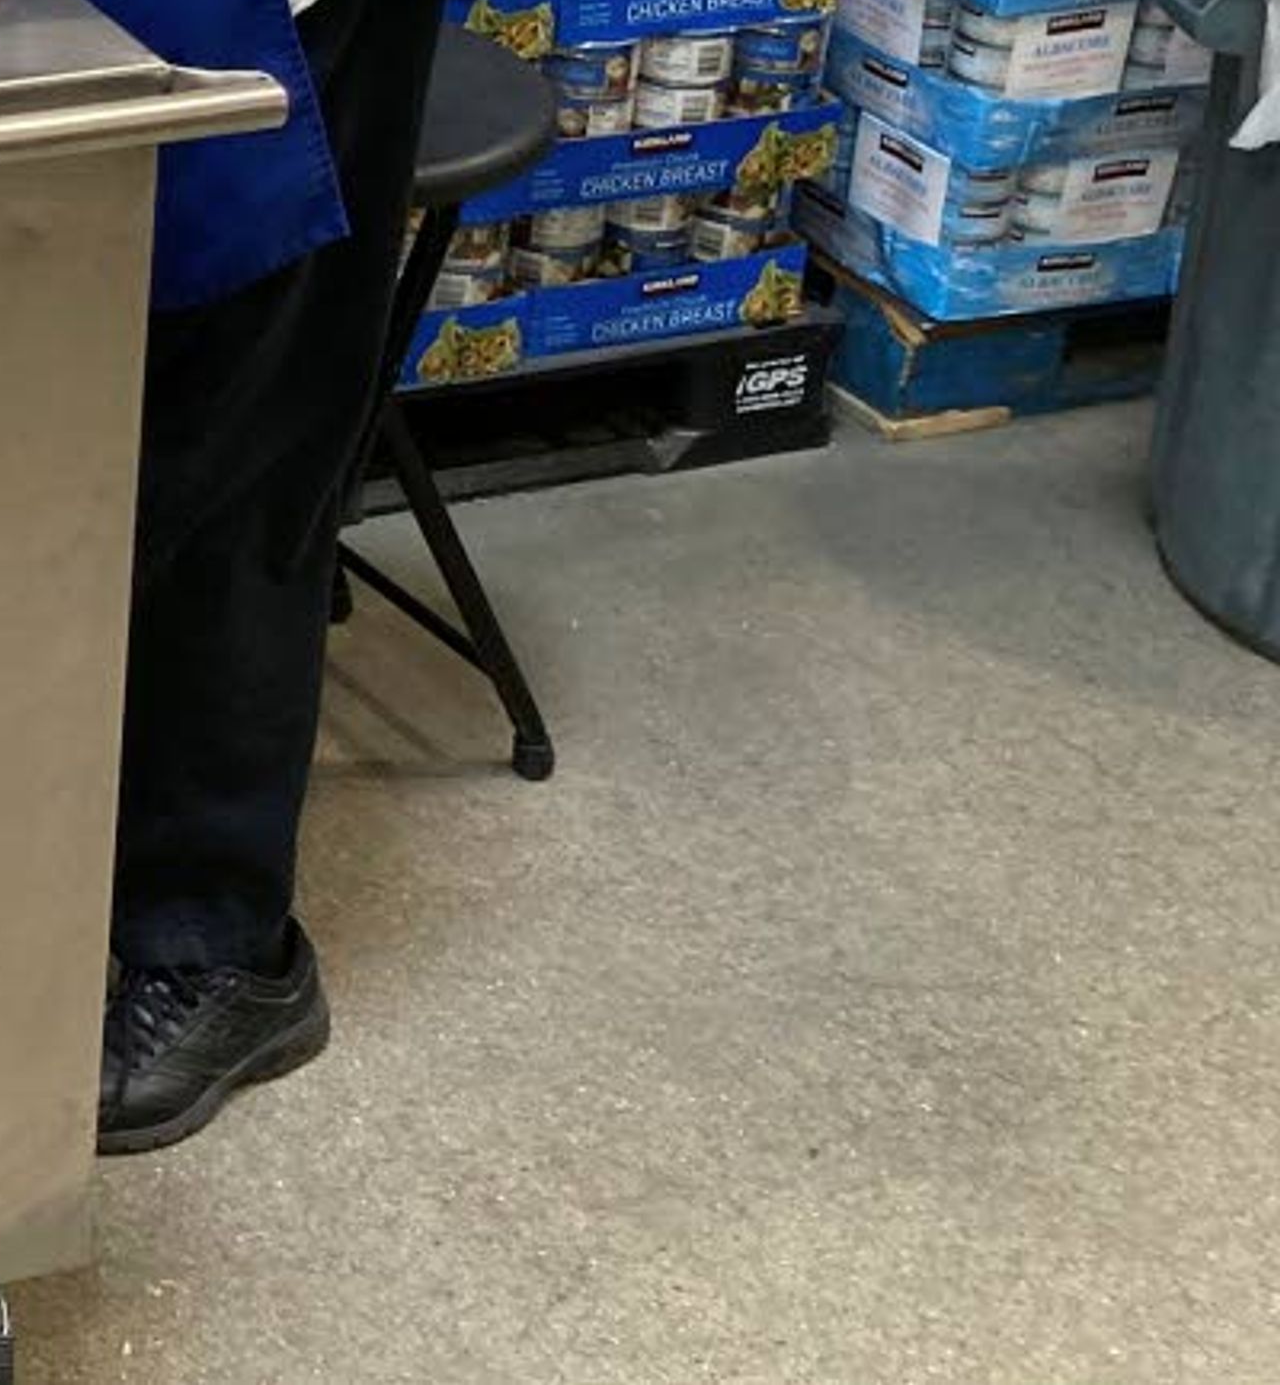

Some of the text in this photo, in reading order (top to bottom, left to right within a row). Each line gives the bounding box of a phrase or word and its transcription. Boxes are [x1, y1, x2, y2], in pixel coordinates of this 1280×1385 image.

[581, 162, 729, 197] CHICKEN BREAST
[591, 301, 736, 342] CHICKEN BREAST
